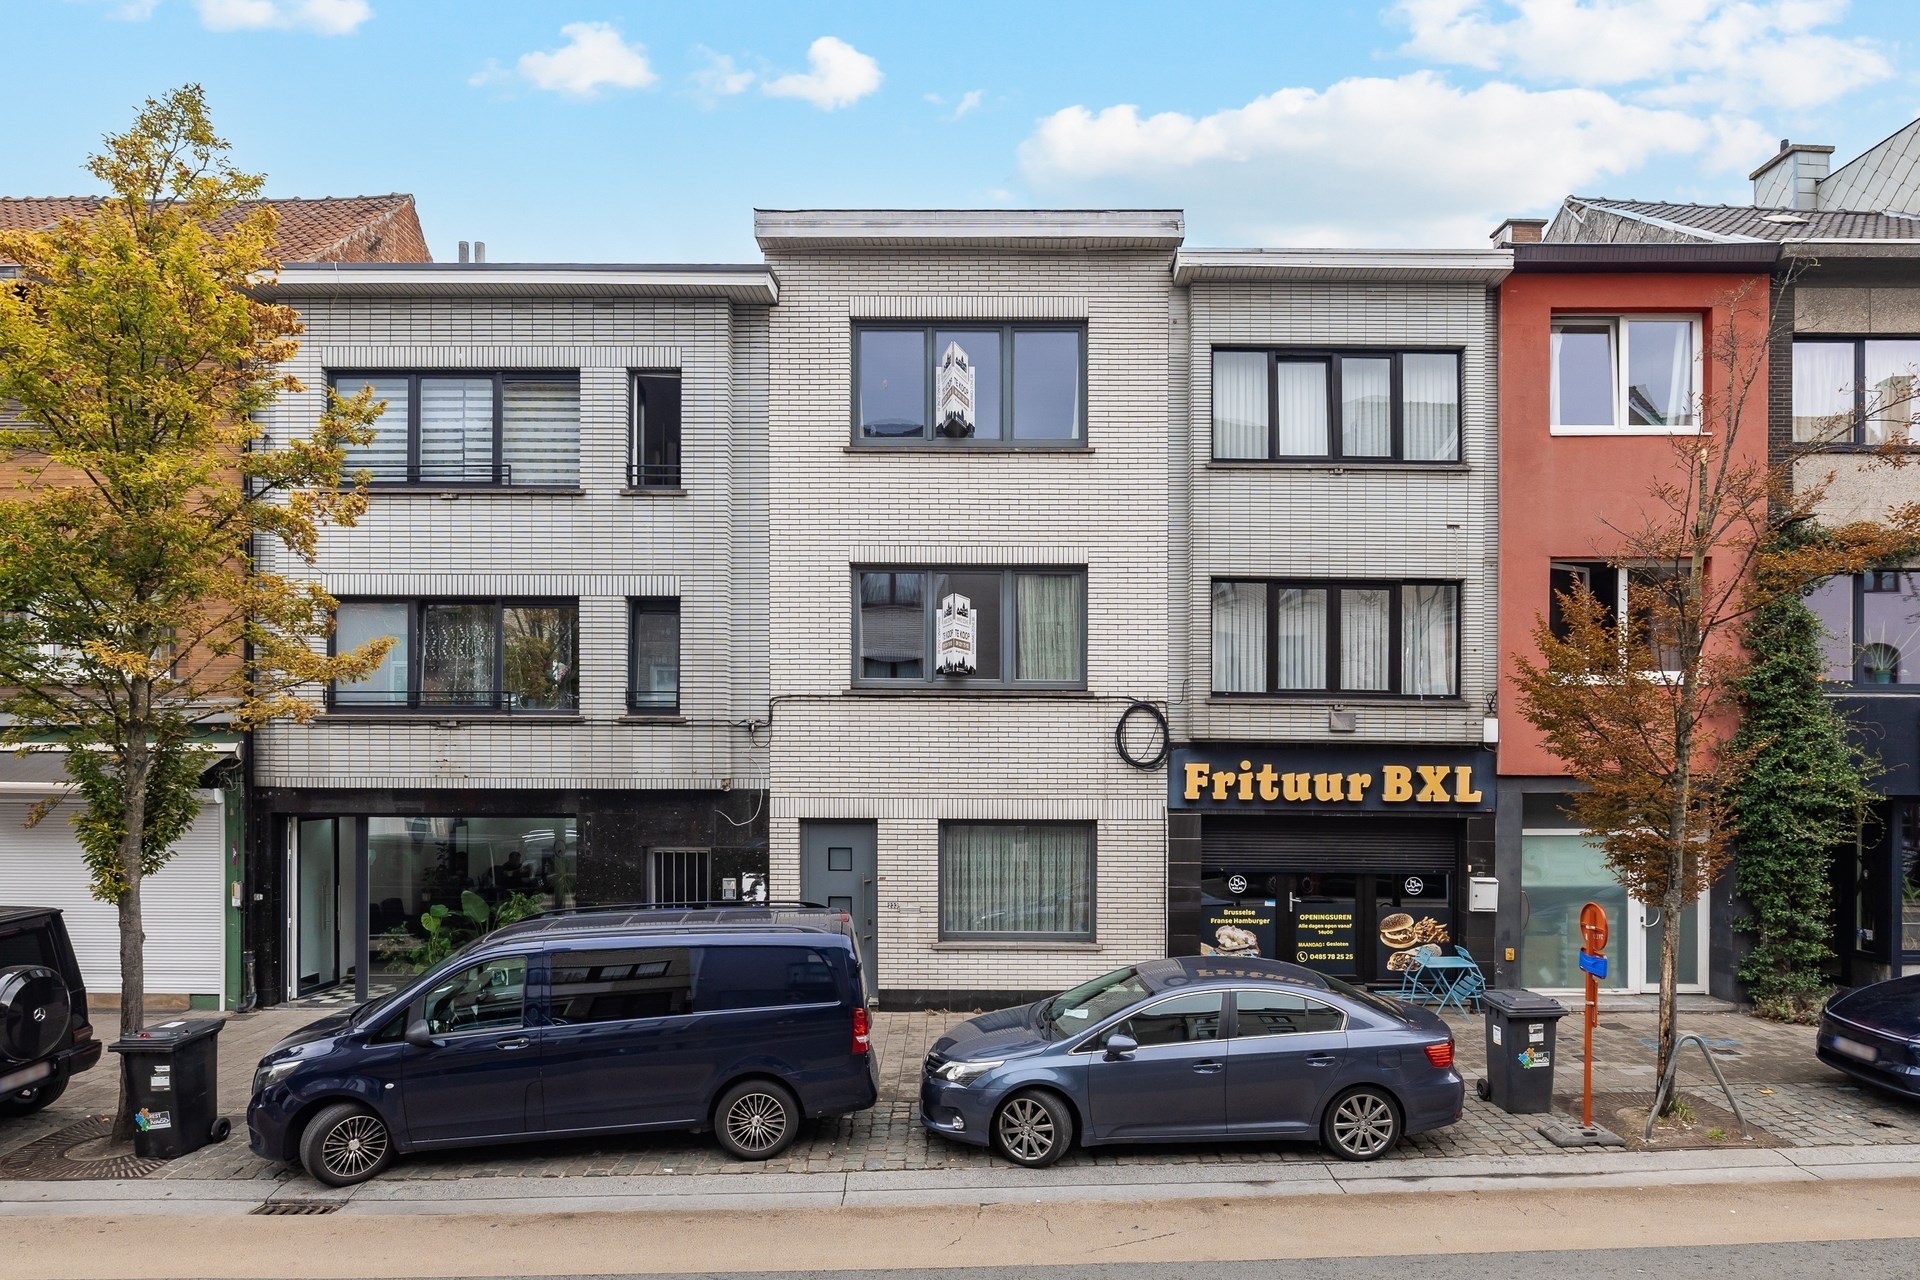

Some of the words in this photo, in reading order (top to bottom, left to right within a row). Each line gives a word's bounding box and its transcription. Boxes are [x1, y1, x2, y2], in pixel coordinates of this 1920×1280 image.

[1184, 760, 1371, 801] Frituur
[1382, 765, 1482, 803] BXL
[1233, 917, 1270, 925] Hamburger
